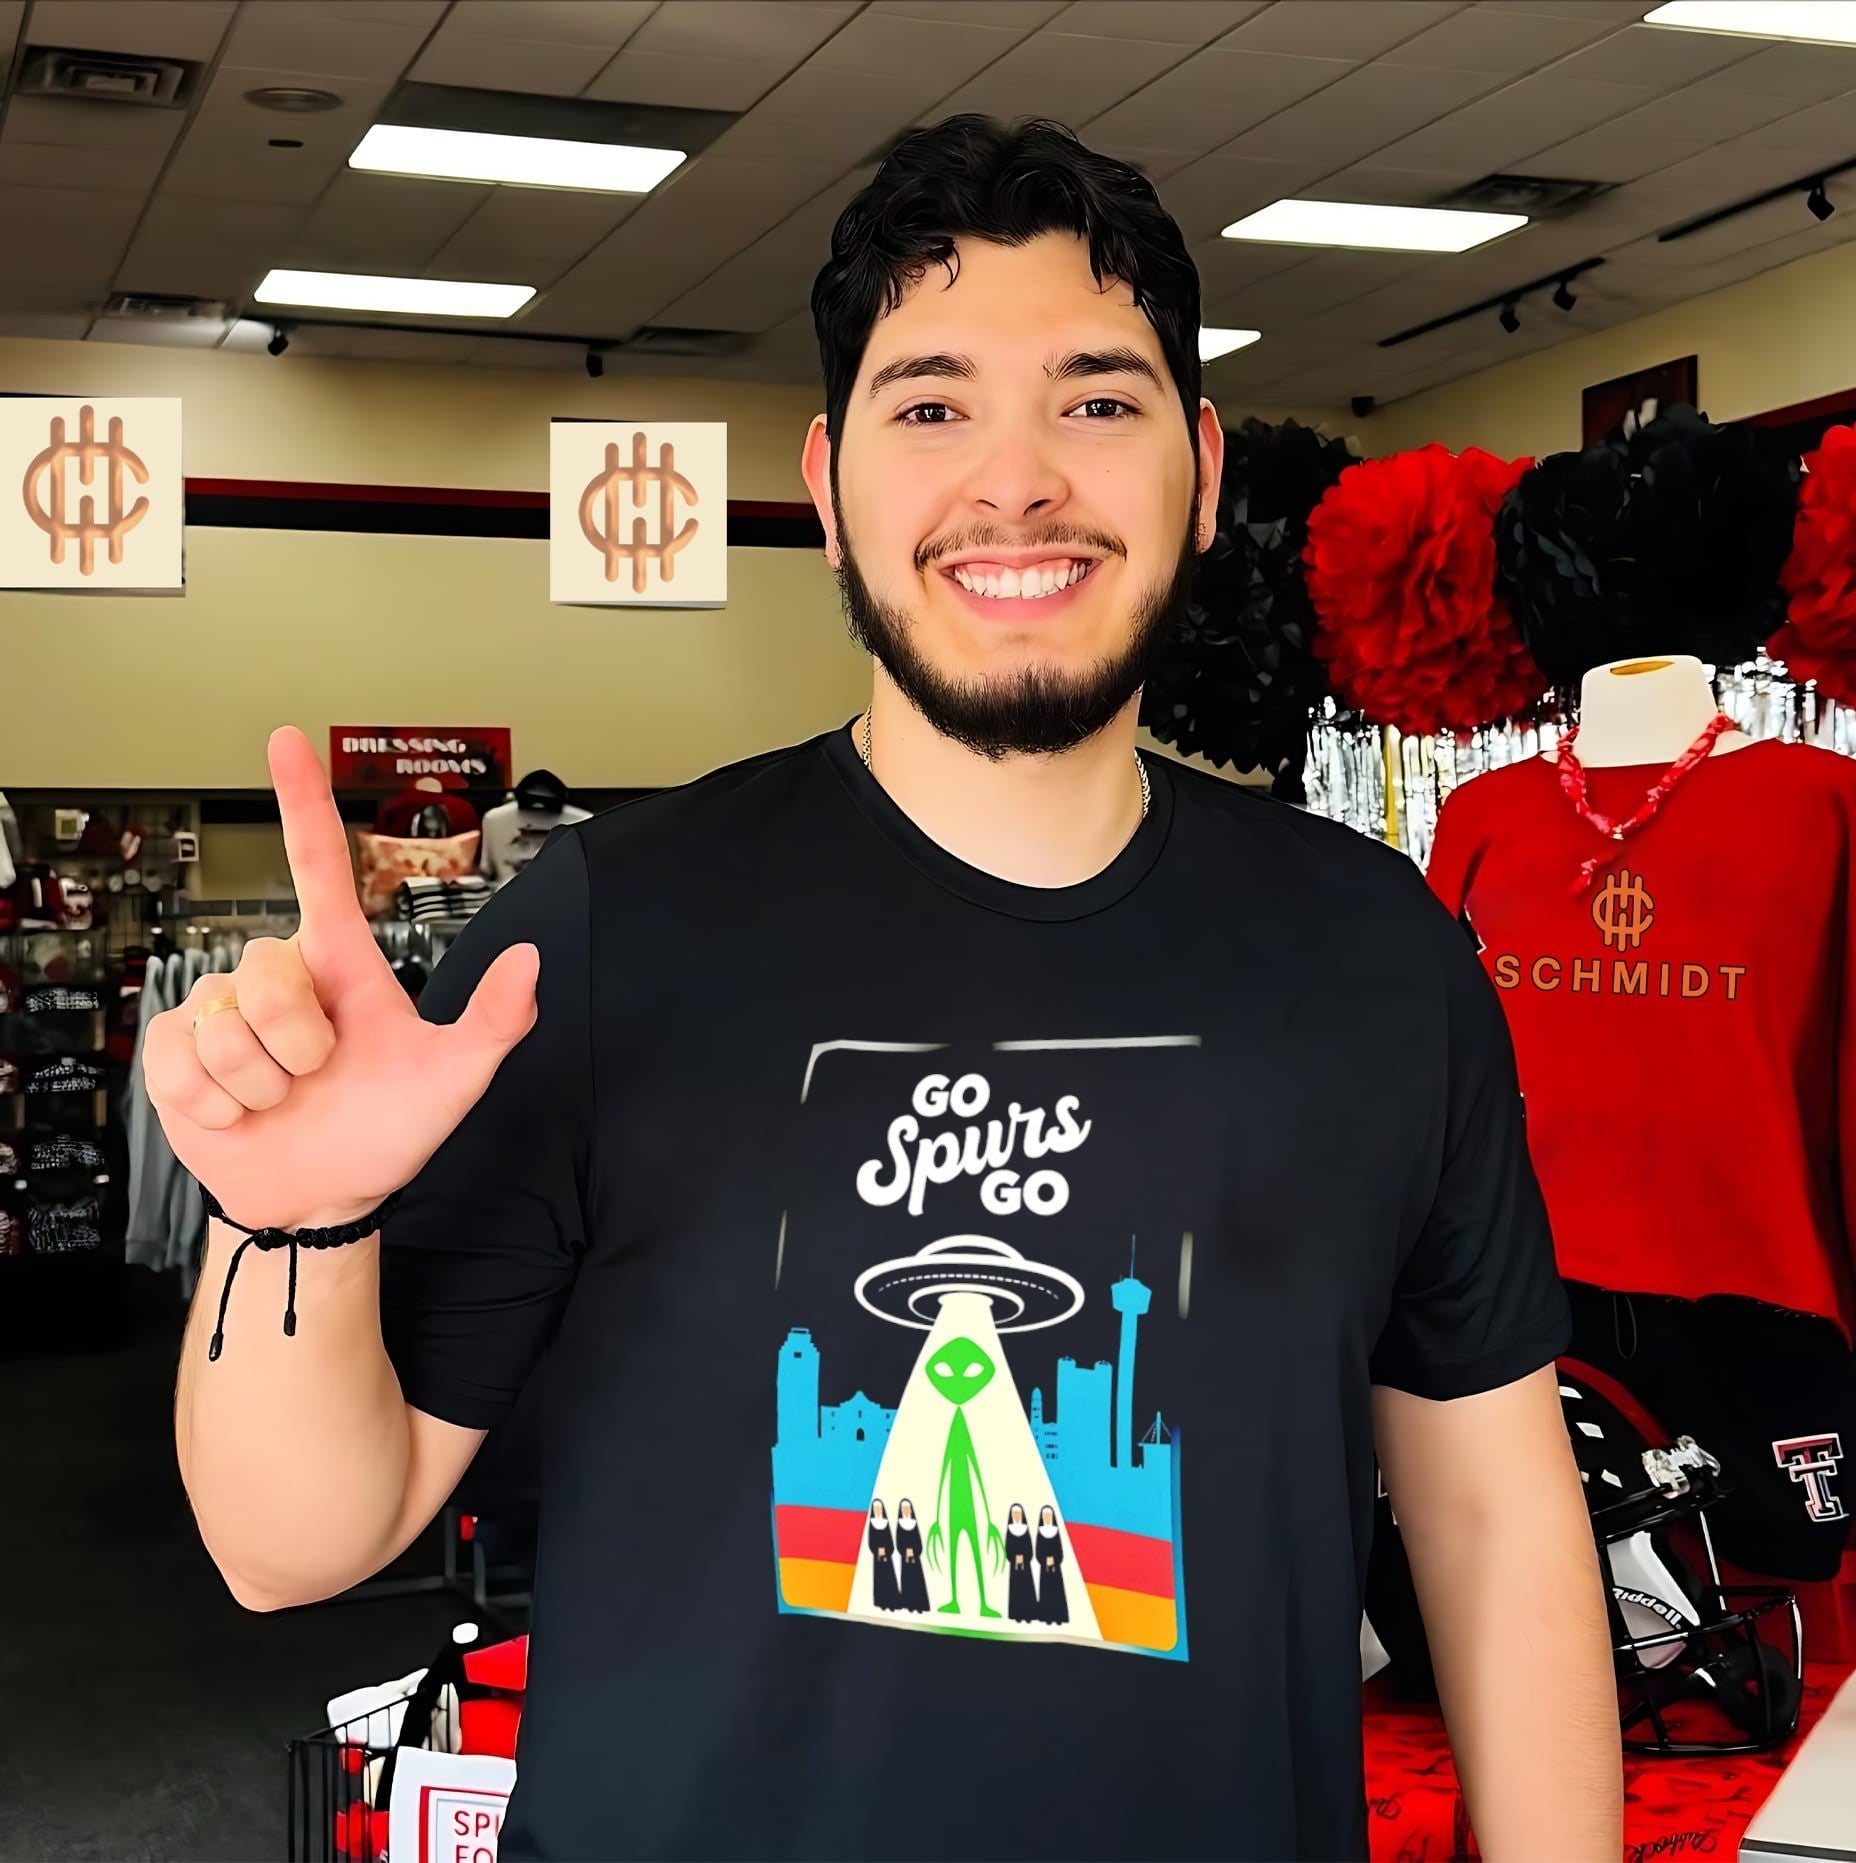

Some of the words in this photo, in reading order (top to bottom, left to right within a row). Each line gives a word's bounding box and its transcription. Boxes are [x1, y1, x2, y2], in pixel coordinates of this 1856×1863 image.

[342, 737, 467, 753] DRESSING
[396, 758, 487, 775] ROOMS
[1494, 954, 1747, 1001] SCHMIDT
[912, 1073, 991, 1117] GO
[856, 1095, 1092, 1216] Spurs
[980, 1169, 1070, 1216] GO
